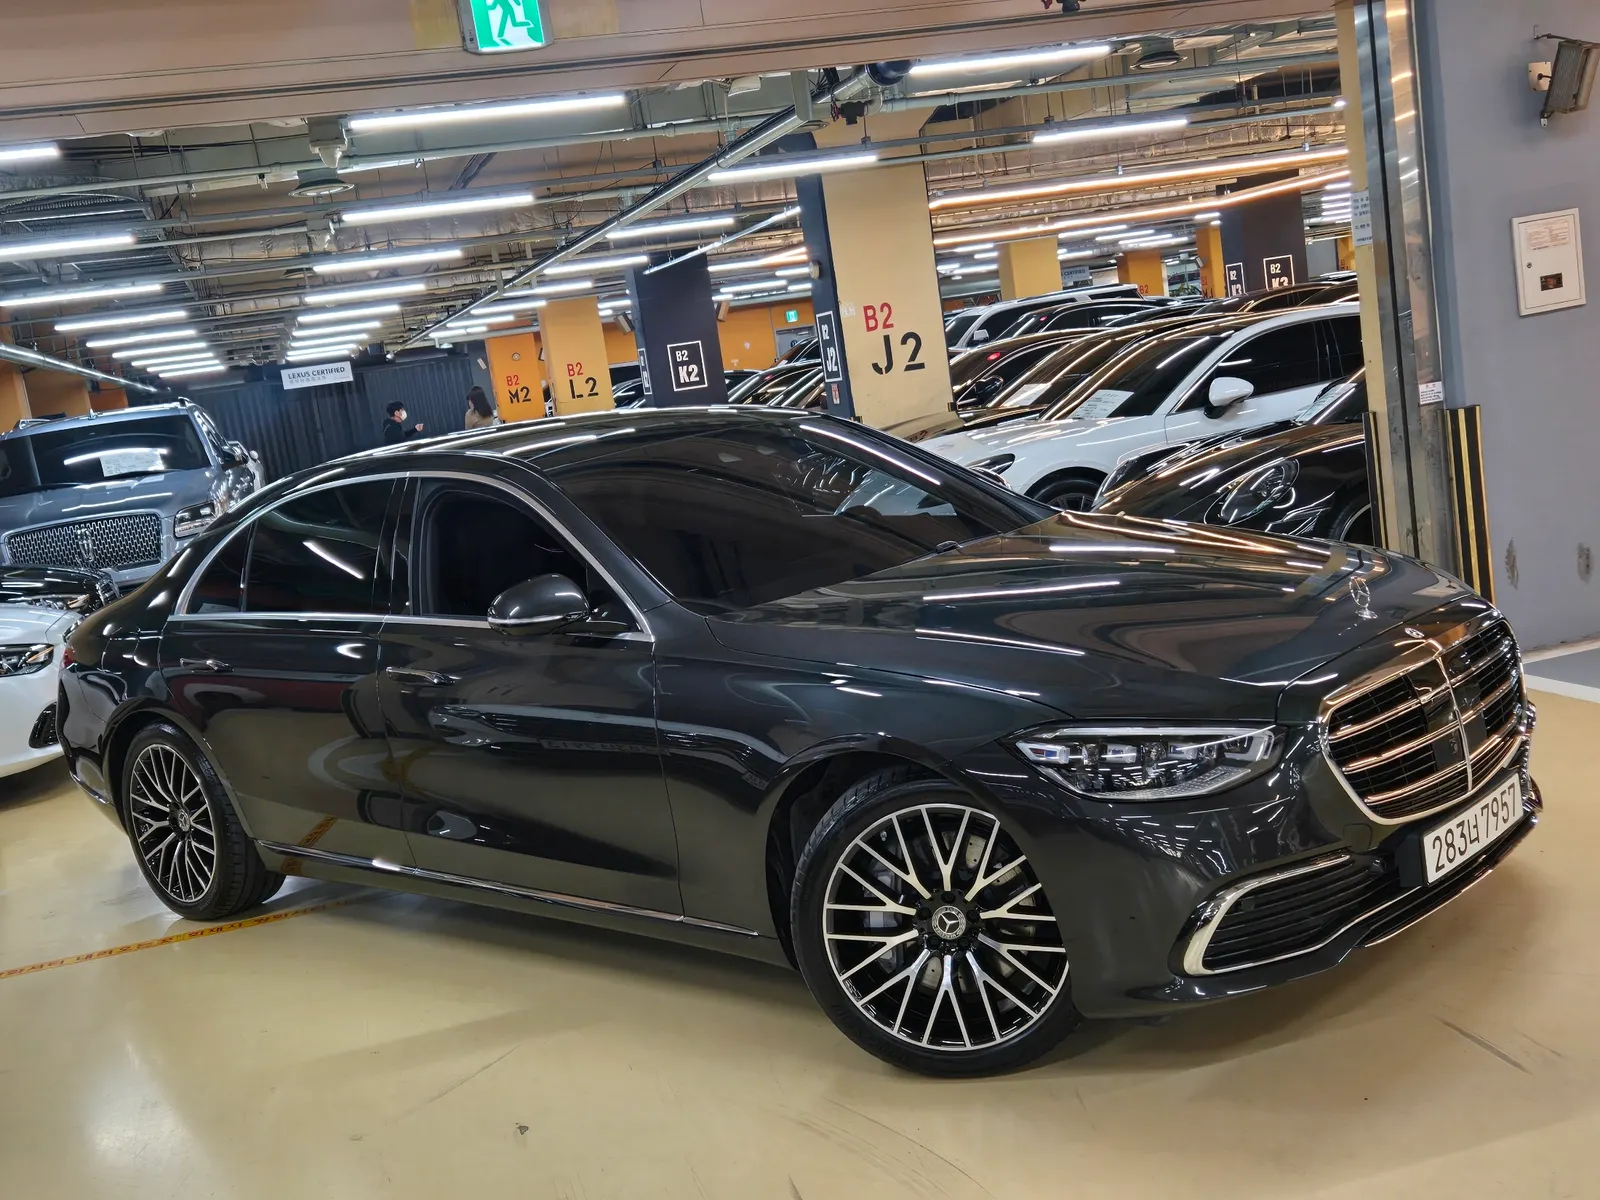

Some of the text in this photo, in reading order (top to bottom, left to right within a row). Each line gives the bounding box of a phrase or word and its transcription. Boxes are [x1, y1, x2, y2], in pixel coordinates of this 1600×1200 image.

[1270, 263, 1281, 274] B2
[1139, 284, 1149, 294] B2
[863, 302, 894, 332] B2
[675, 350, 689, 362] B2
[826, 346, 838, 373] J2
[871, 331, 925, 375] J2
[288, 370, 311, 380] LEXUS
[311, 366, 346, 377] CERTIFIED
[566, 362, 584, 377] B2
[678, 364, 700, 384] K2
[506, 374, 520, 386] B2
[569, 376, 599, 400] L2
[508, 386, 532, 404] M2
[1432, 782, 1516, 873] 283너7957
